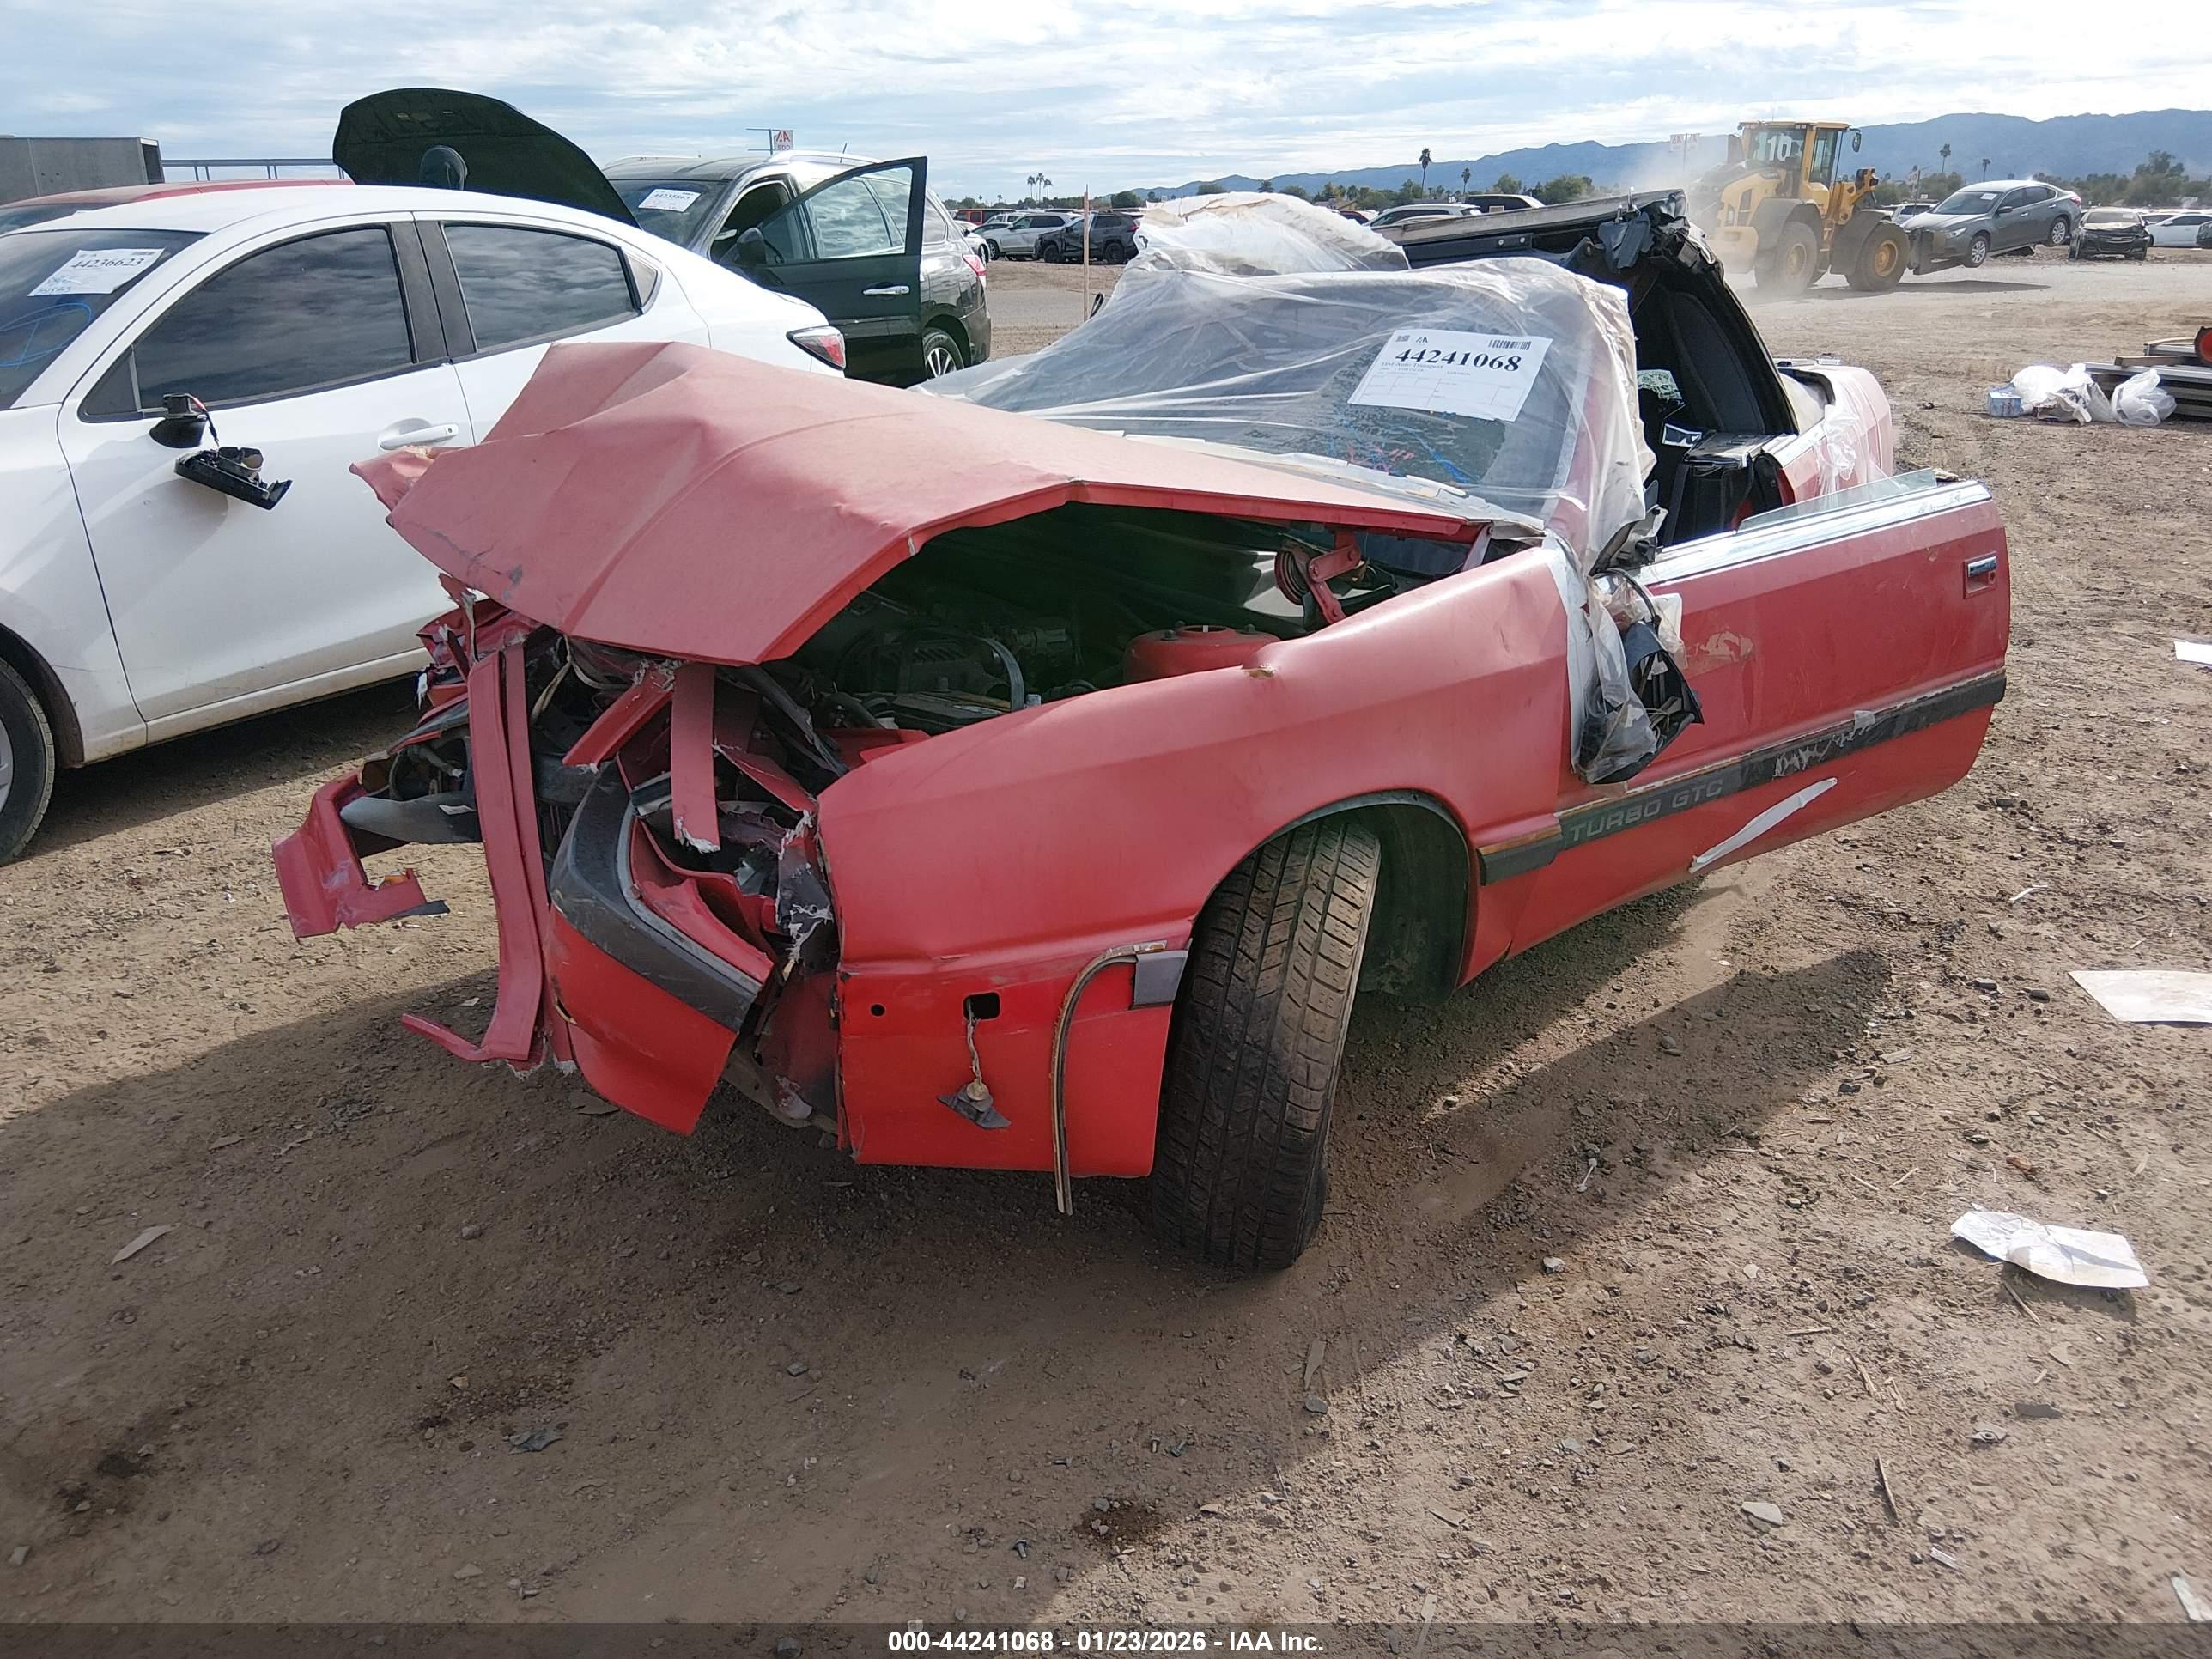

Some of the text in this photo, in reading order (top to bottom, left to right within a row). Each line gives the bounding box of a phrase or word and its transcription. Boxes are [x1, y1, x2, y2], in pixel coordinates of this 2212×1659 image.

[1767, 134, 1792, 161] 10
[70, 258, 144, 268] 44236623
[1395, 349, 1522, 372] 44241068
[1571, 778, 1724, 842] TURBO GTC
